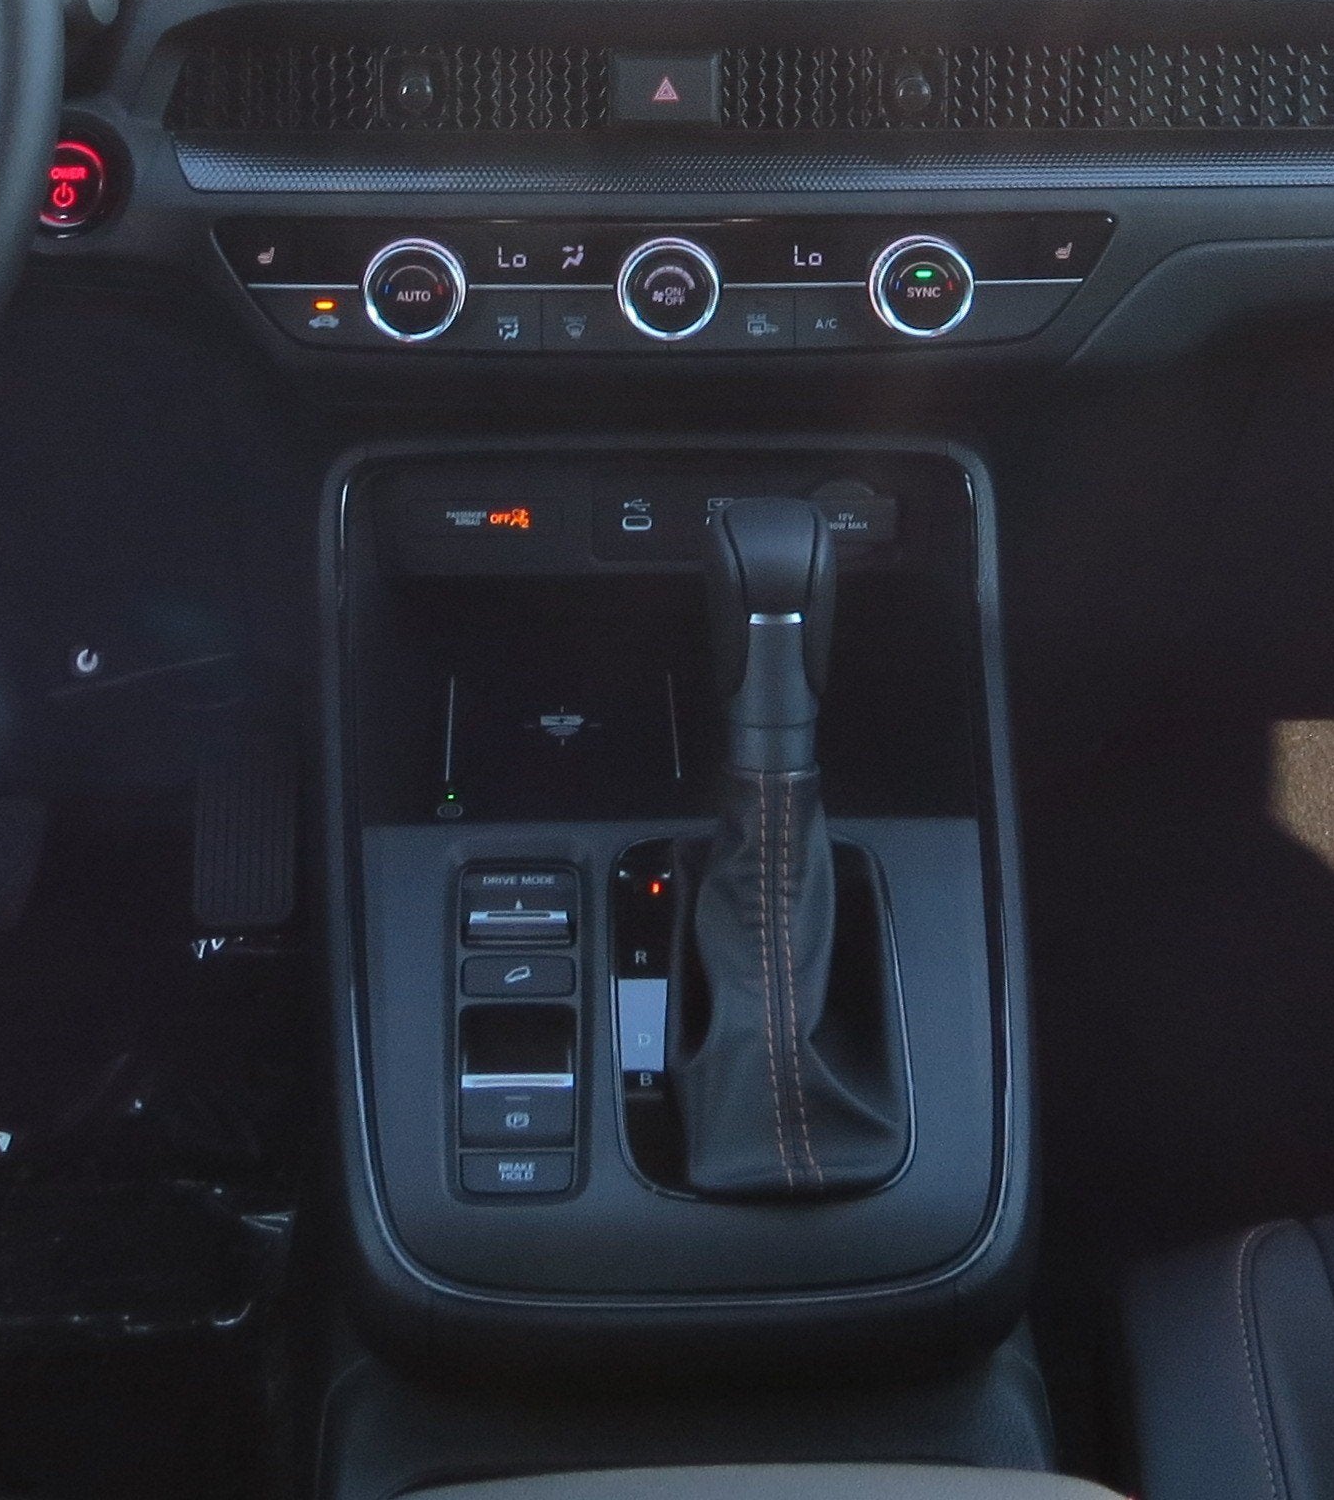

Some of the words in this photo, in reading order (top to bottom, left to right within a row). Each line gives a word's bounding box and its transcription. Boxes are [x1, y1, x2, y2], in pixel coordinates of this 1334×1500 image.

[498, 246, 527, 268] Lo
[794, 245, 822, 266] Lo
[396, 290, 431, 302] AUTO
[906, 287, 942, 298] SYNC
[664, 296, 686, 306] OFF
[815, 318, 838, 329] A/C
[490, 513, 512, 524] OFF
[482, 876, 516, 886] DRIVE
[520, 875, 555, 885] MODE
[635, 950, 647, 964] R
[640, 1072, 653, 1087] B
[501, 1171, 534, 1182] HOLD
